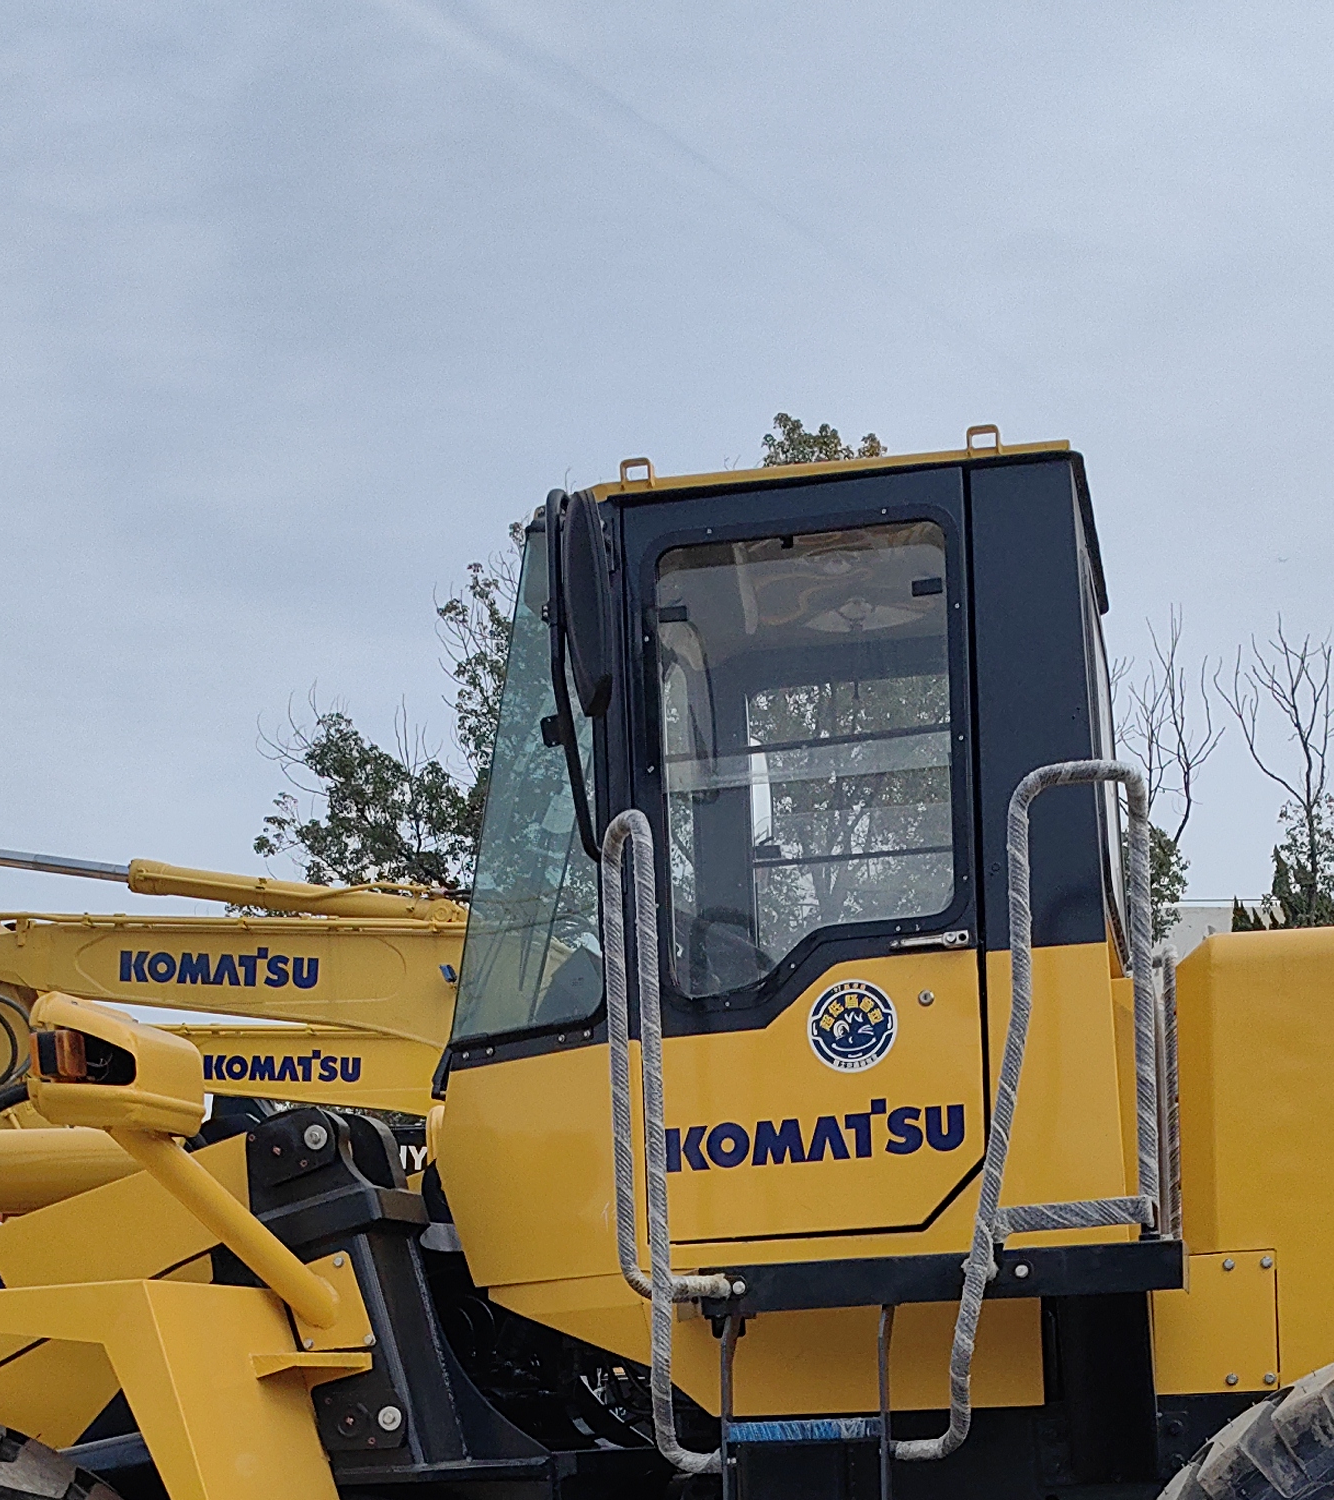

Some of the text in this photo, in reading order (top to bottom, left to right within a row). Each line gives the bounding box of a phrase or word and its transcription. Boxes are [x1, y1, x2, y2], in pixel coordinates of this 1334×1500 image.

[119, 947, 319, 989] KOMATSU
[203, 1049, 362, 1083] KOMATSU
[665, 1097, 965, 1173] KOMATSU
